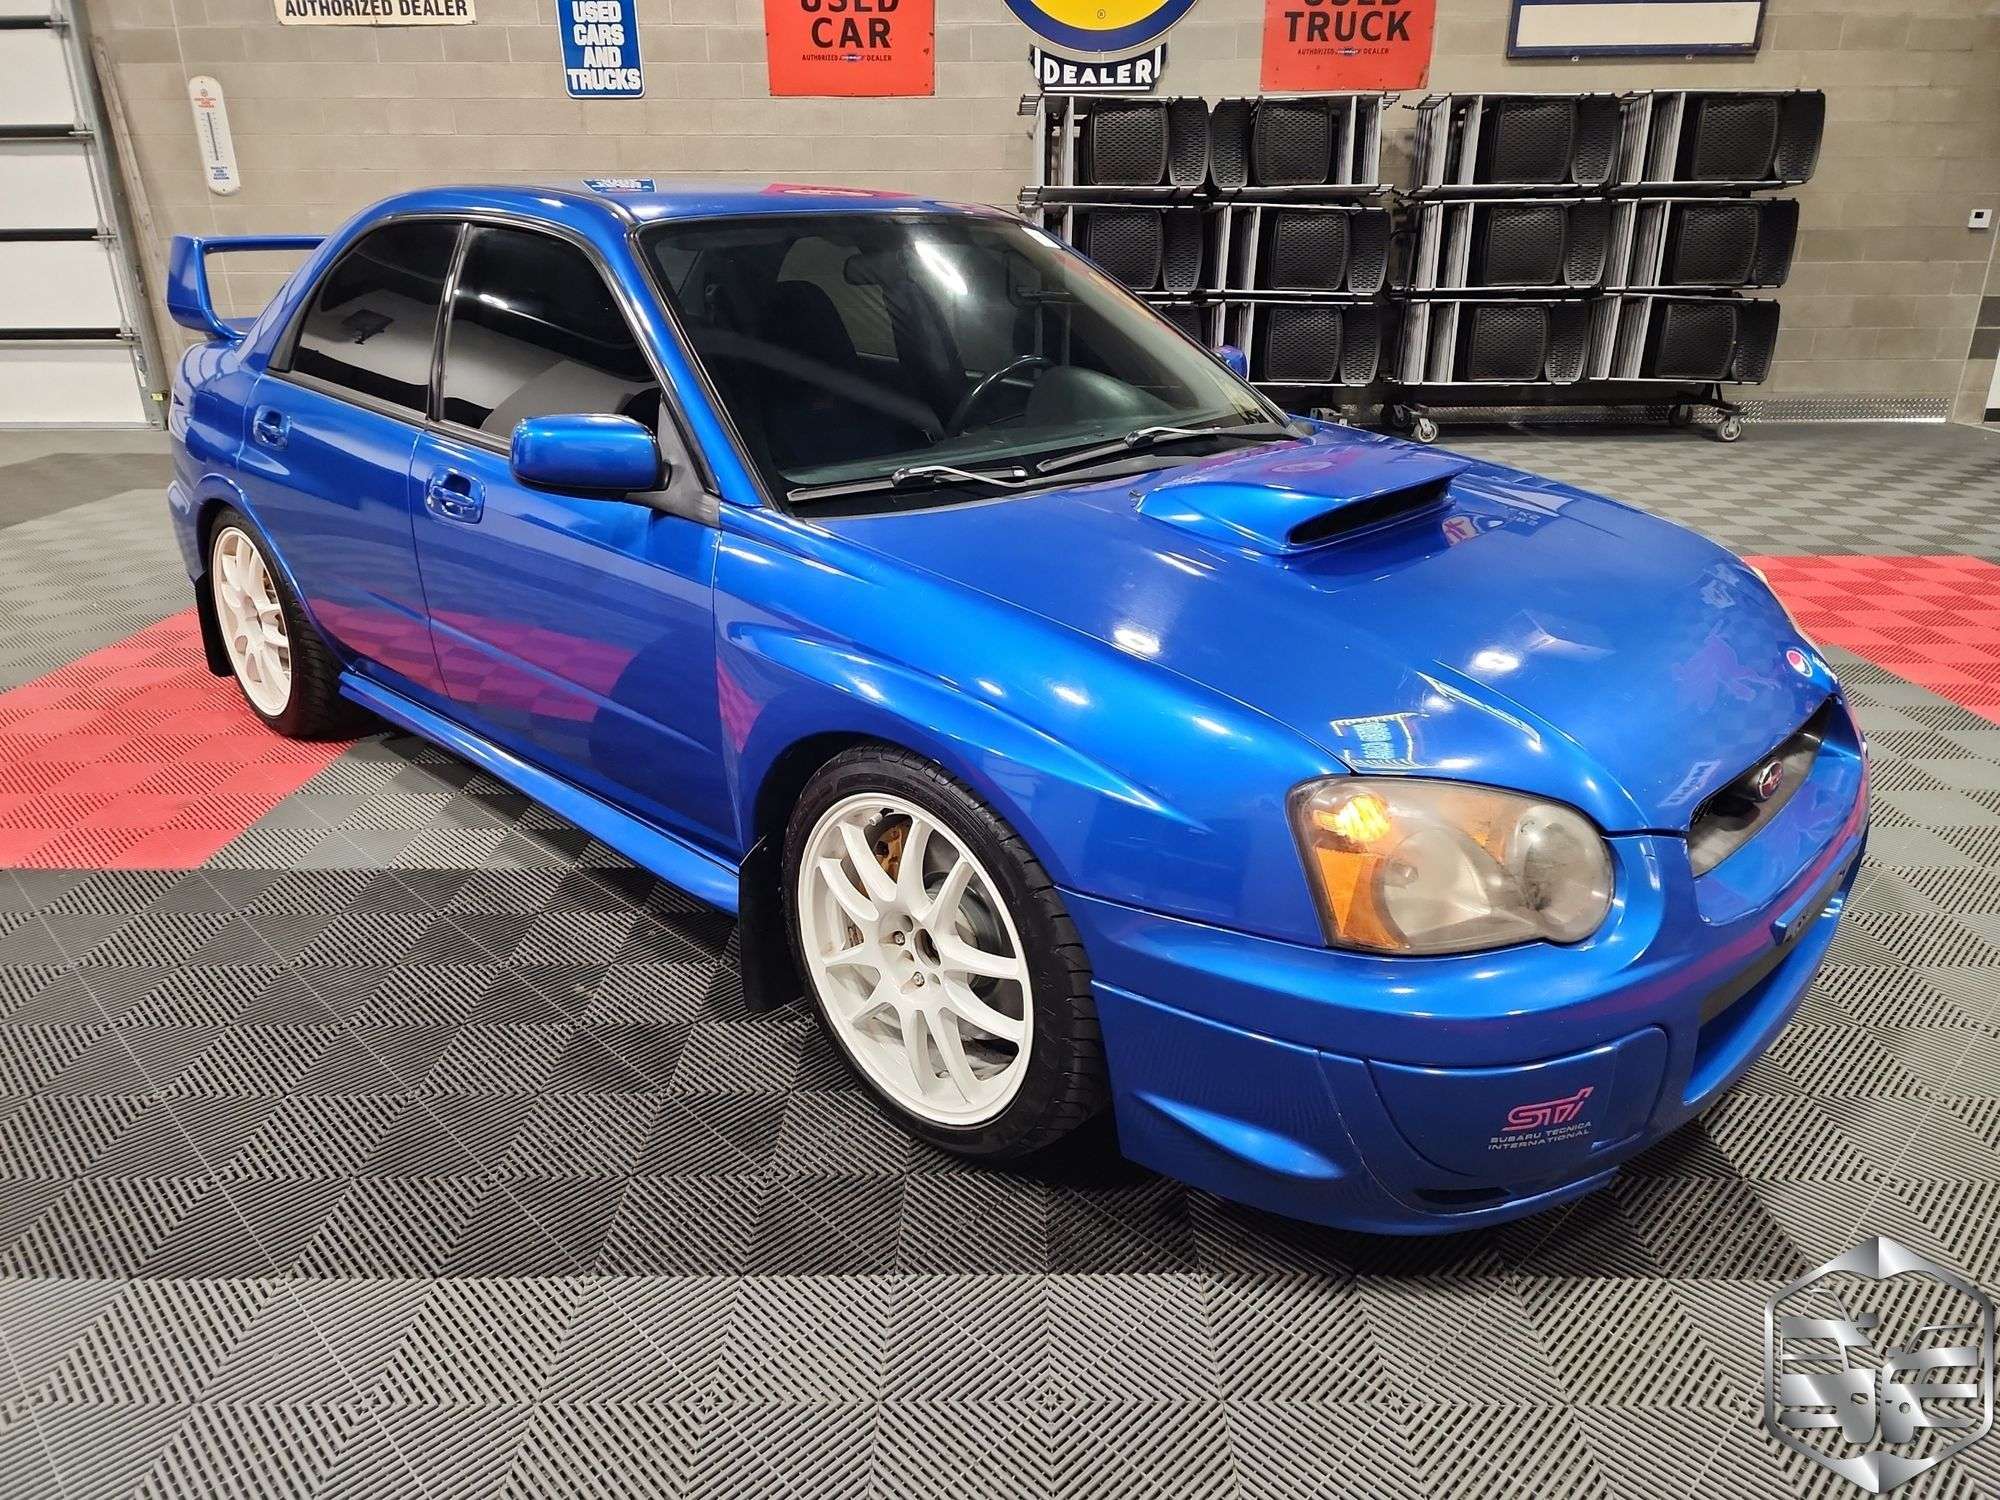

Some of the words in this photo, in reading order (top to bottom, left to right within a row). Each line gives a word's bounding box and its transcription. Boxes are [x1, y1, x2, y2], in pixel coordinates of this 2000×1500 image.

[285, 0, 393, 16] AUTHORIZED
[400, 0, 468, 16] DEALER
[572, 0, 622, 23] USED
[573, 23, 624, 46] CARS
[811, 17, 892, 49] CAR
[1284, 11, 1412, 42] TRUCK
[583, 46, 622, 68] AND
[567, 68, 641, 90] TRUCKS
[1043, 57, 1153, 85] DEALER
[1488, 1129, 1591, 1151] INTERNATIONAL
[1490, 1132, 1542, 1144] SUBARU
[1545, 1121, 1592, 1137] TECNICA
